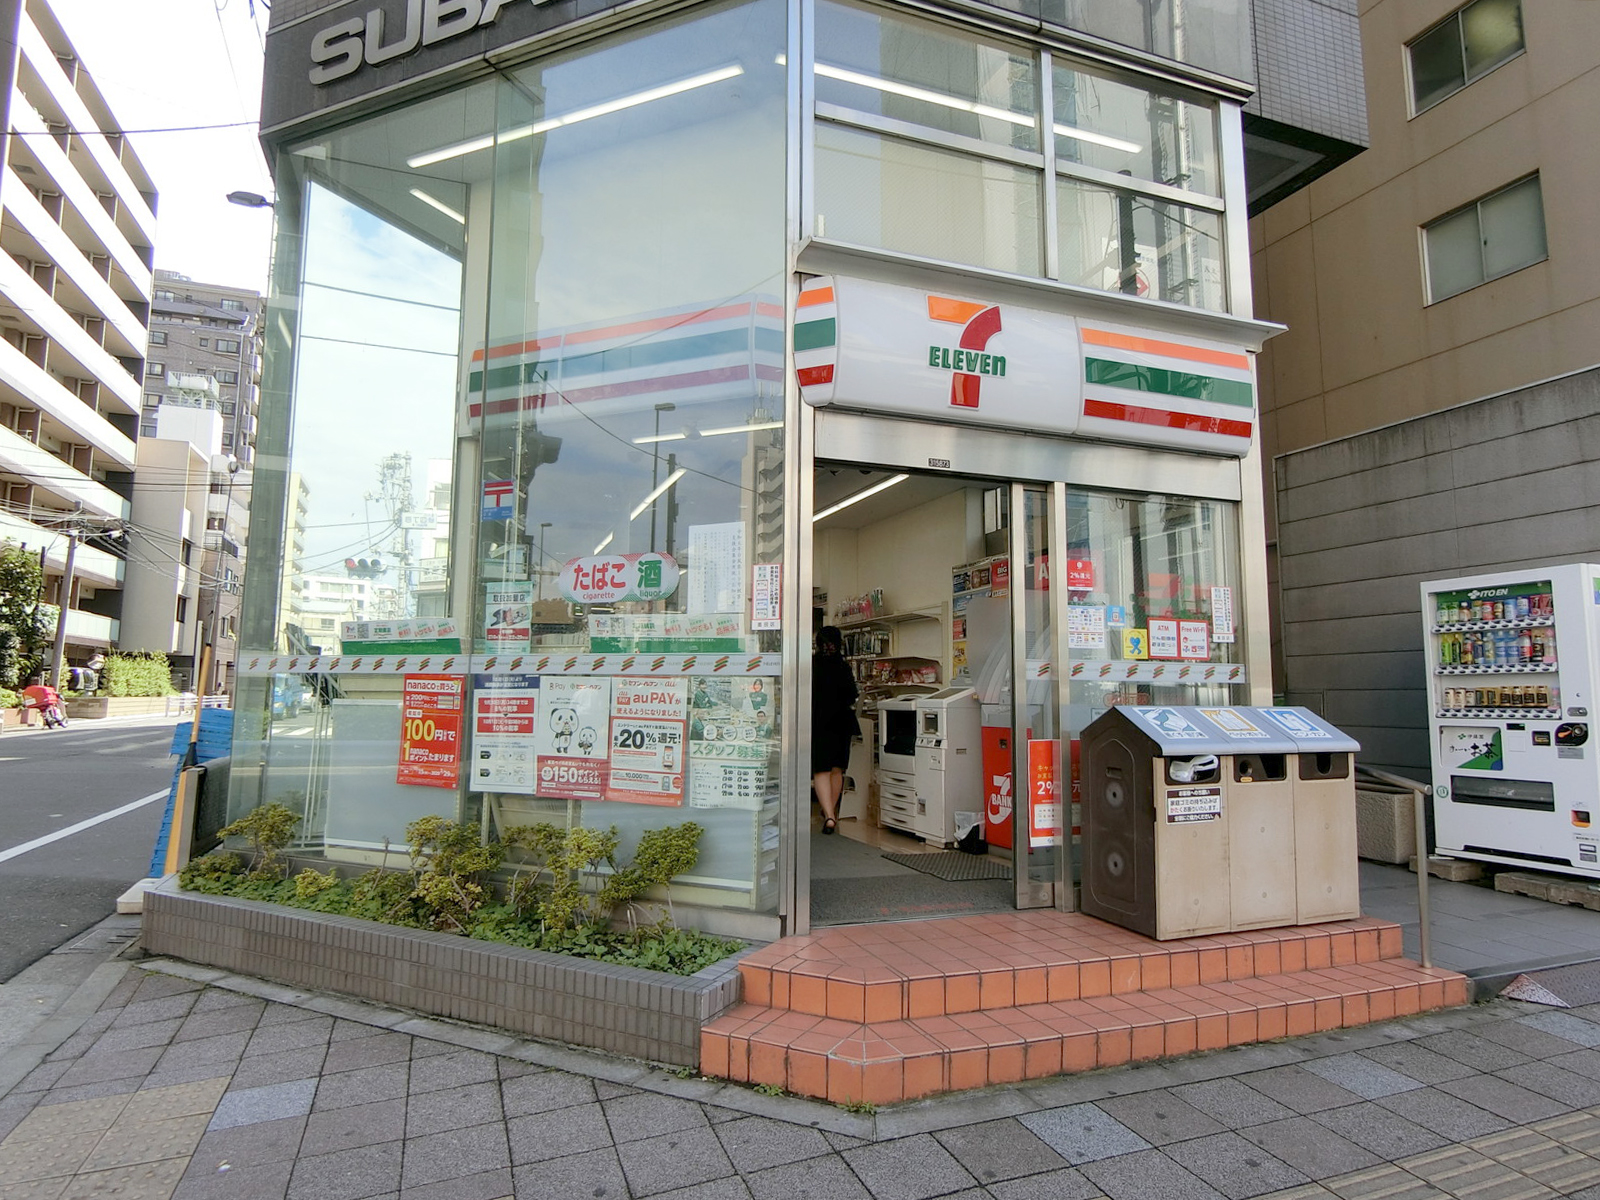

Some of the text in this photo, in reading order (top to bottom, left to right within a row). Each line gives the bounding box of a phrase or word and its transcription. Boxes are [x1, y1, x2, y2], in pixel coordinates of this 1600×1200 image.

[308, 0, 549, 85] SUB
[637, 559, 662, 588] 酒
[997, 566, 1008, 574] BIG
[573, 562, 626, 591] たばこ
[582, 591, 616, 600] cigarette
[639, 590, 662, 598] liquor
[1496, 588, 1508, 596] EN
[633, 694, 649, 704] au
[616, 707, 682, 717] 使えるようになりました!
[991, 793, 1012, 808] BANK
